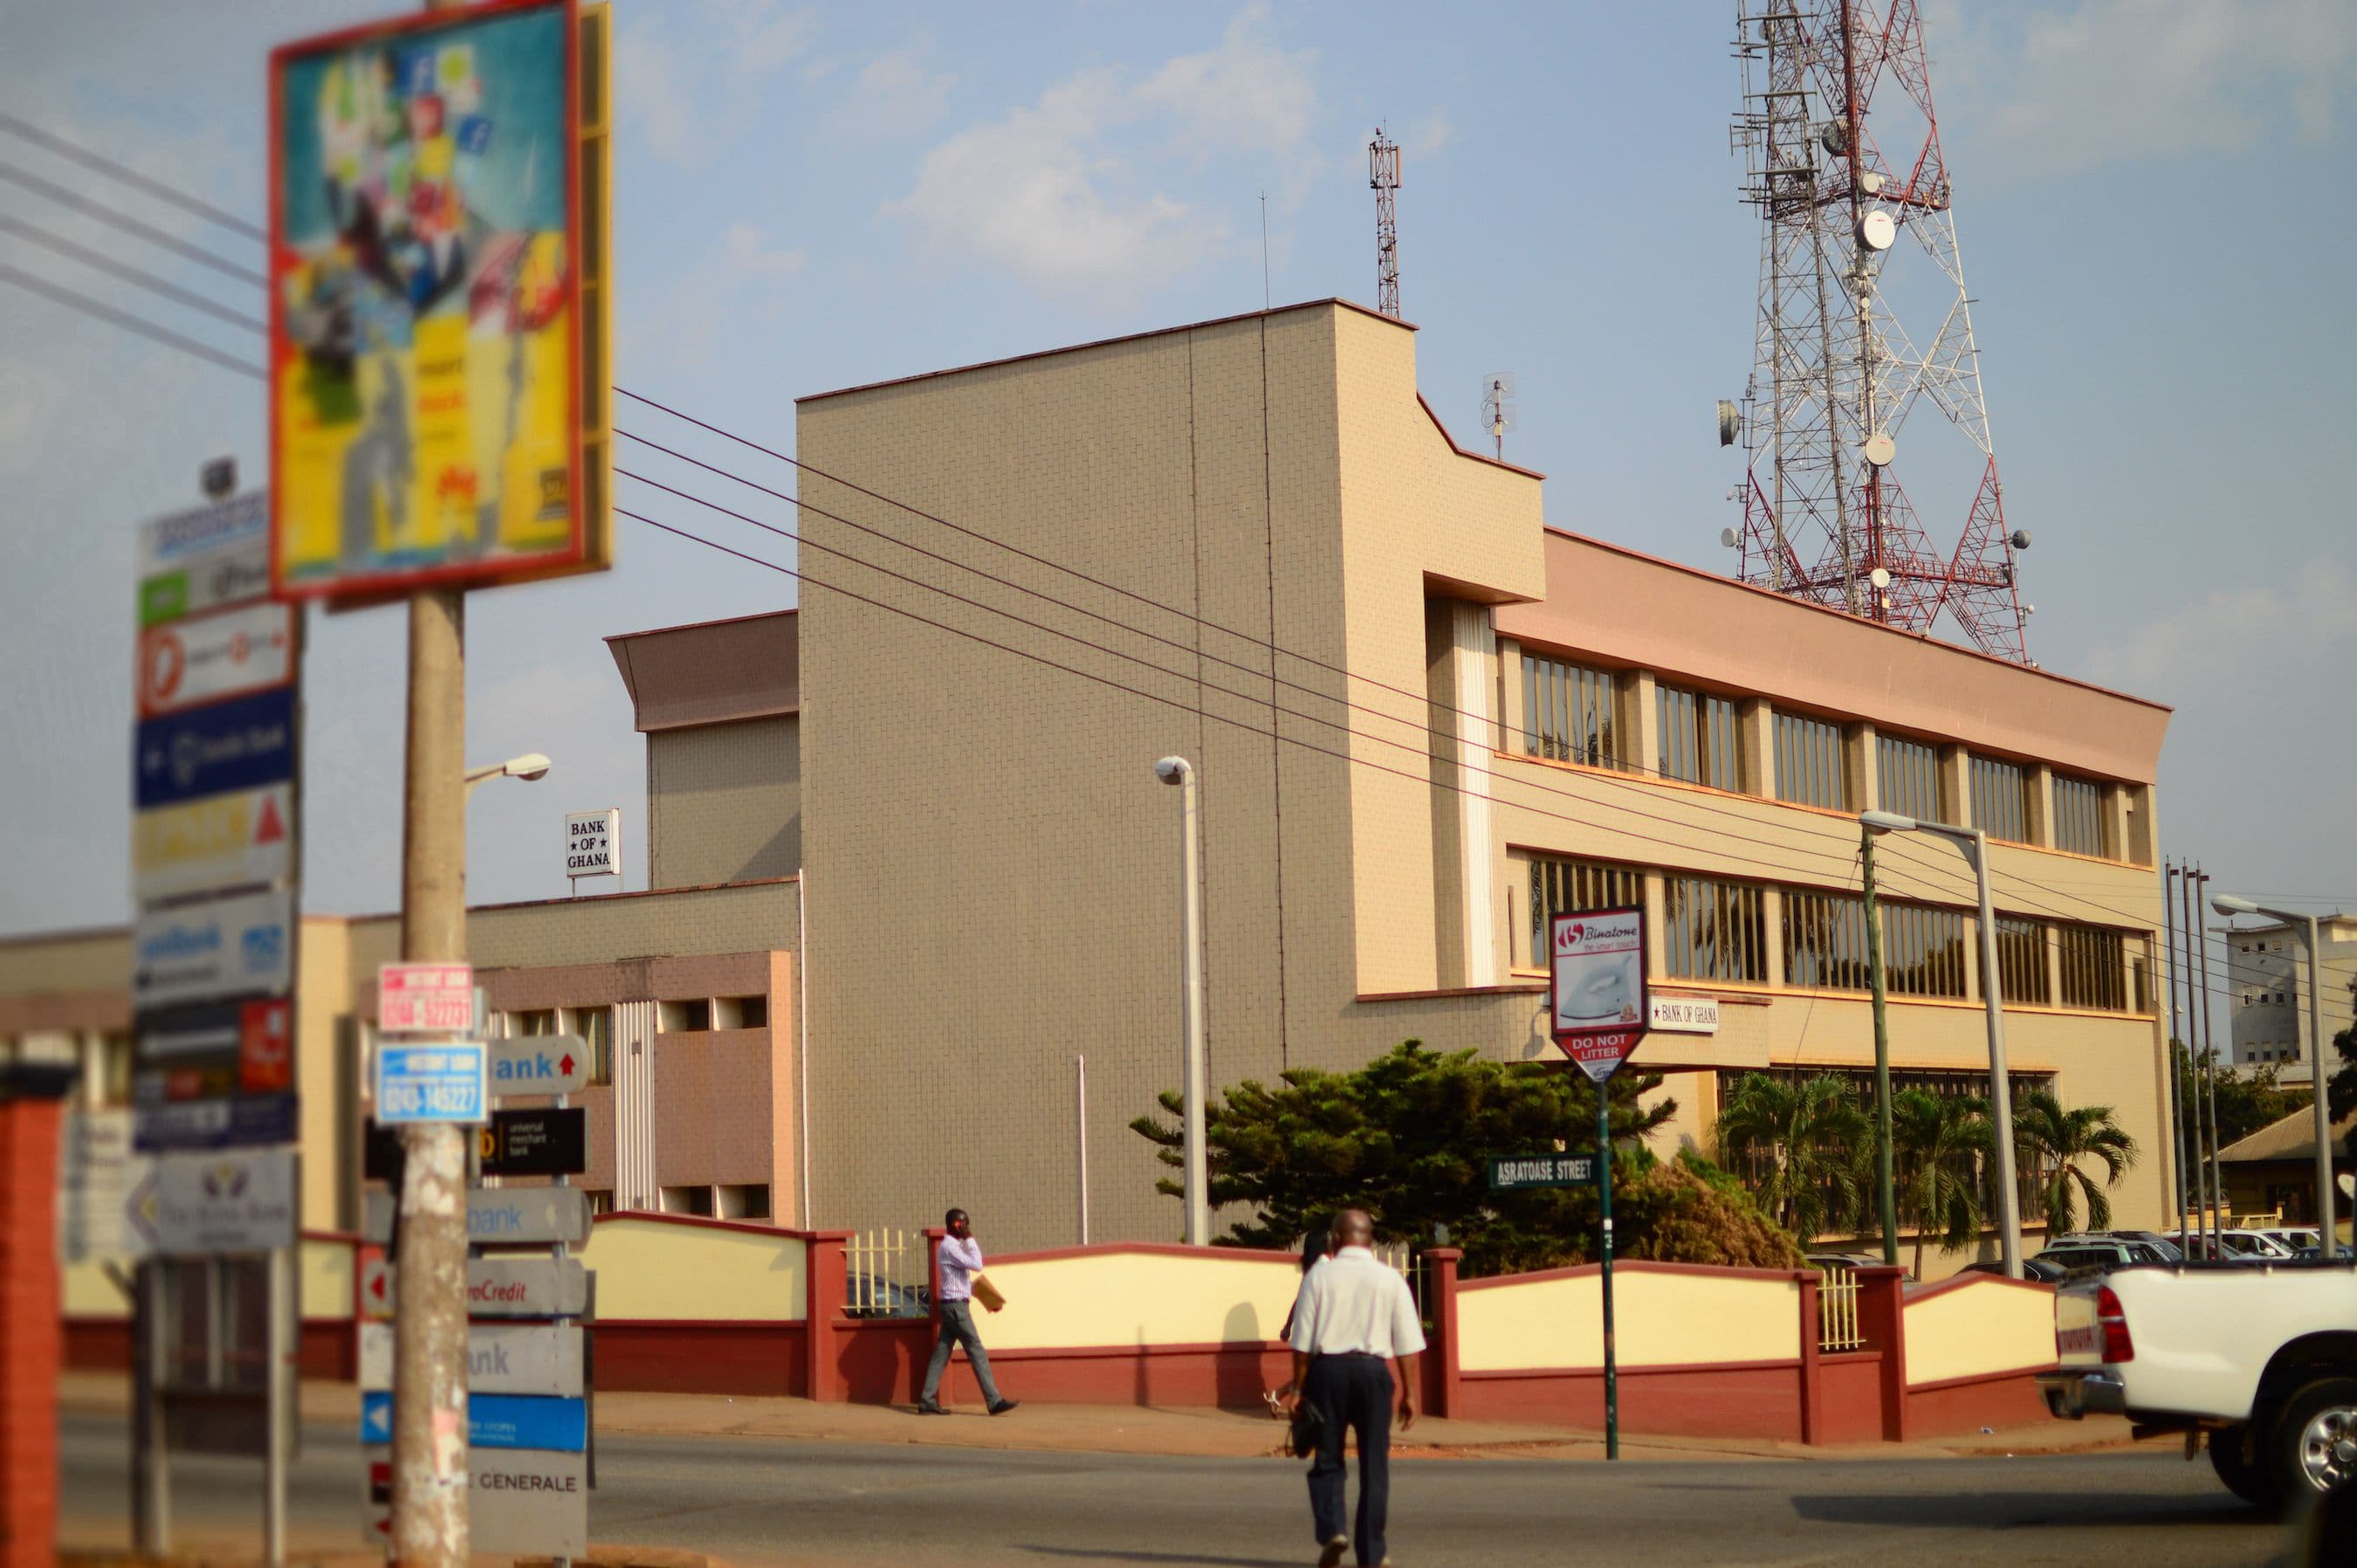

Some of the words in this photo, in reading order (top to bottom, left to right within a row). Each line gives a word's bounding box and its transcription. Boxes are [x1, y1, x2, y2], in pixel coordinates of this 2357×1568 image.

[572, 821, 605, 836] BANK
[581, 838, 596, 850] OF
[567, 853, 610, 868] GHANA
[1584, 926, 1637, 940] Binatone
[1596, 943, 1613, 952] smart
[1662, 1004, 1682, 1022] BANK
[1684, 1006, 1693, 1022] OF
[1695, 1007, 1717, 1023] GHANA
[1572, 1037, 1593, 1049] DO
[1597, 1034, 1627, 1047] NOT
[1581, 1048, 1619, 1059] LITTER
[509, 1145, 528, 1156] bank
[1498, 1159, 1553, 1182] ASRATOASE
[1556, 1159, 1591, 1180] STREET
[480, 1473, 577, 1493] GENERALE
